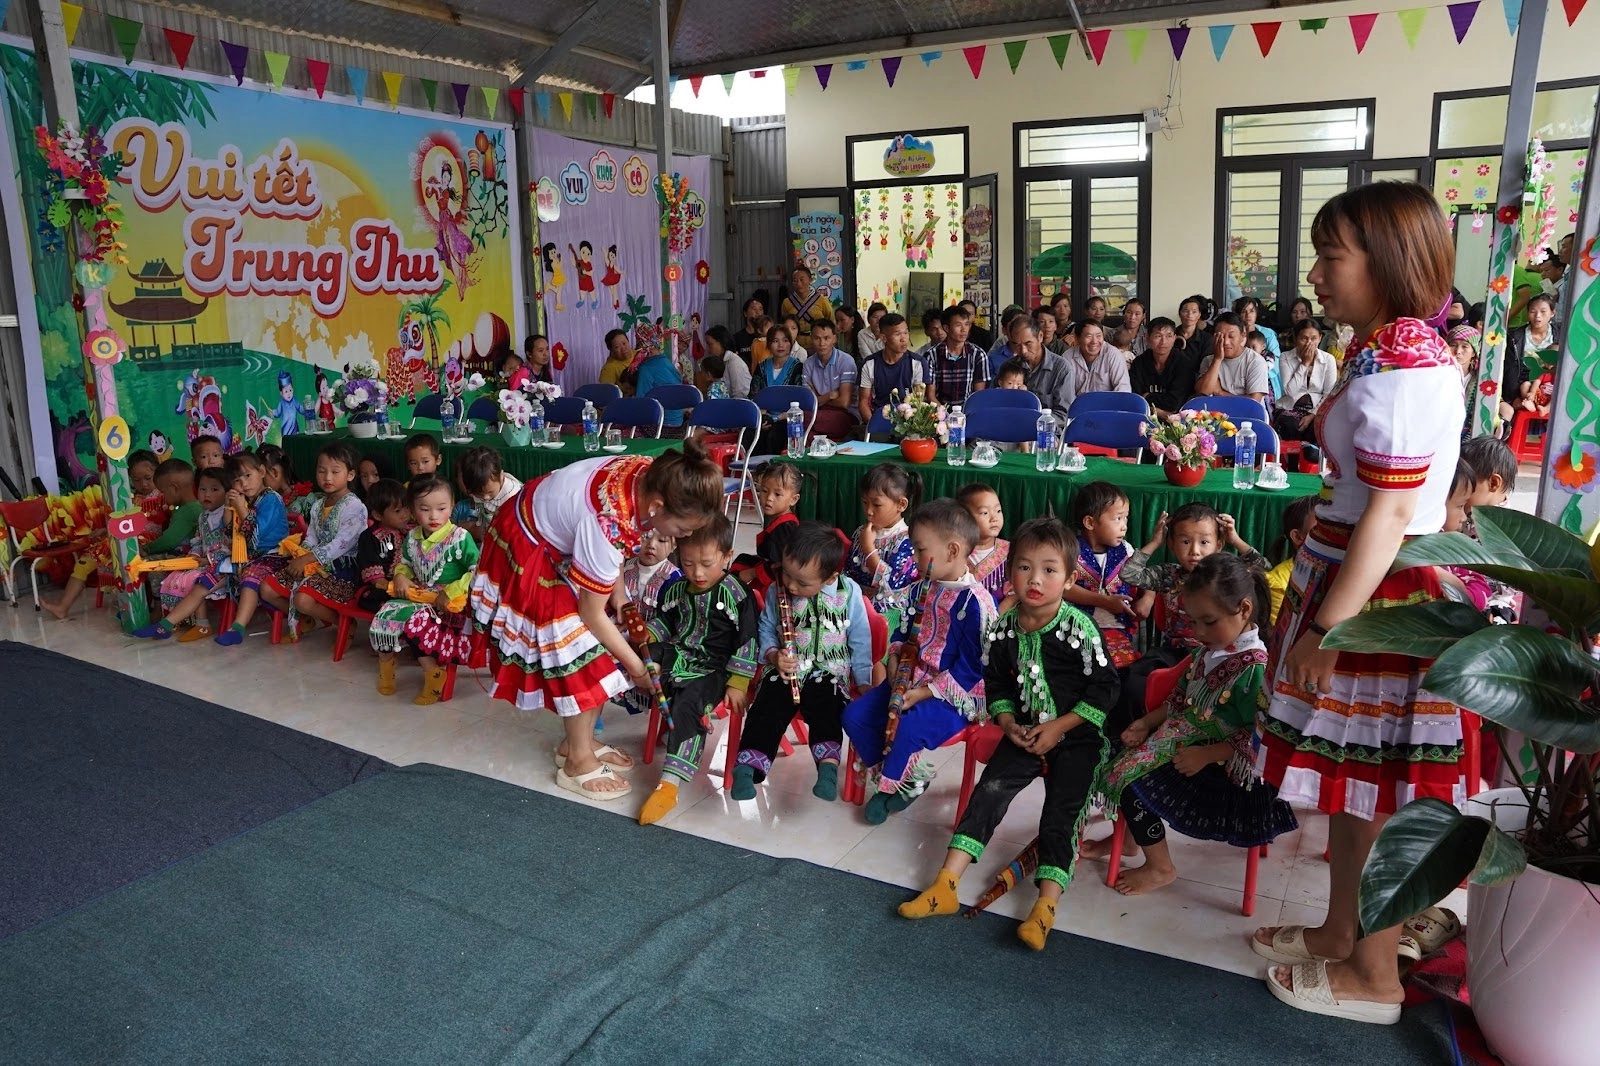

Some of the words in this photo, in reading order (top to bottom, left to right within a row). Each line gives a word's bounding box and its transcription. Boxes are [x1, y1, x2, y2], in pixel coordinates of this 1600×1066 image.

[113, 125, 244, 198] Vui
[253, 144, 316, 206] tết
[565, 177, 584, 194] VUI
[630, 166, 643, 186] CÔ
[537, 188, 554, 210] BÉ
[797, 215, 813, 225] một
[815, 215, 837, 225] ngày
[800, 226, 817, 235] của
[820, 224, 832, 234] bé
[190, 216, 343, 305] Trung
[355, 224, 439, 283] Thu
[106, 425, 124, 450] 6
[118, 518, 135, 534] a
